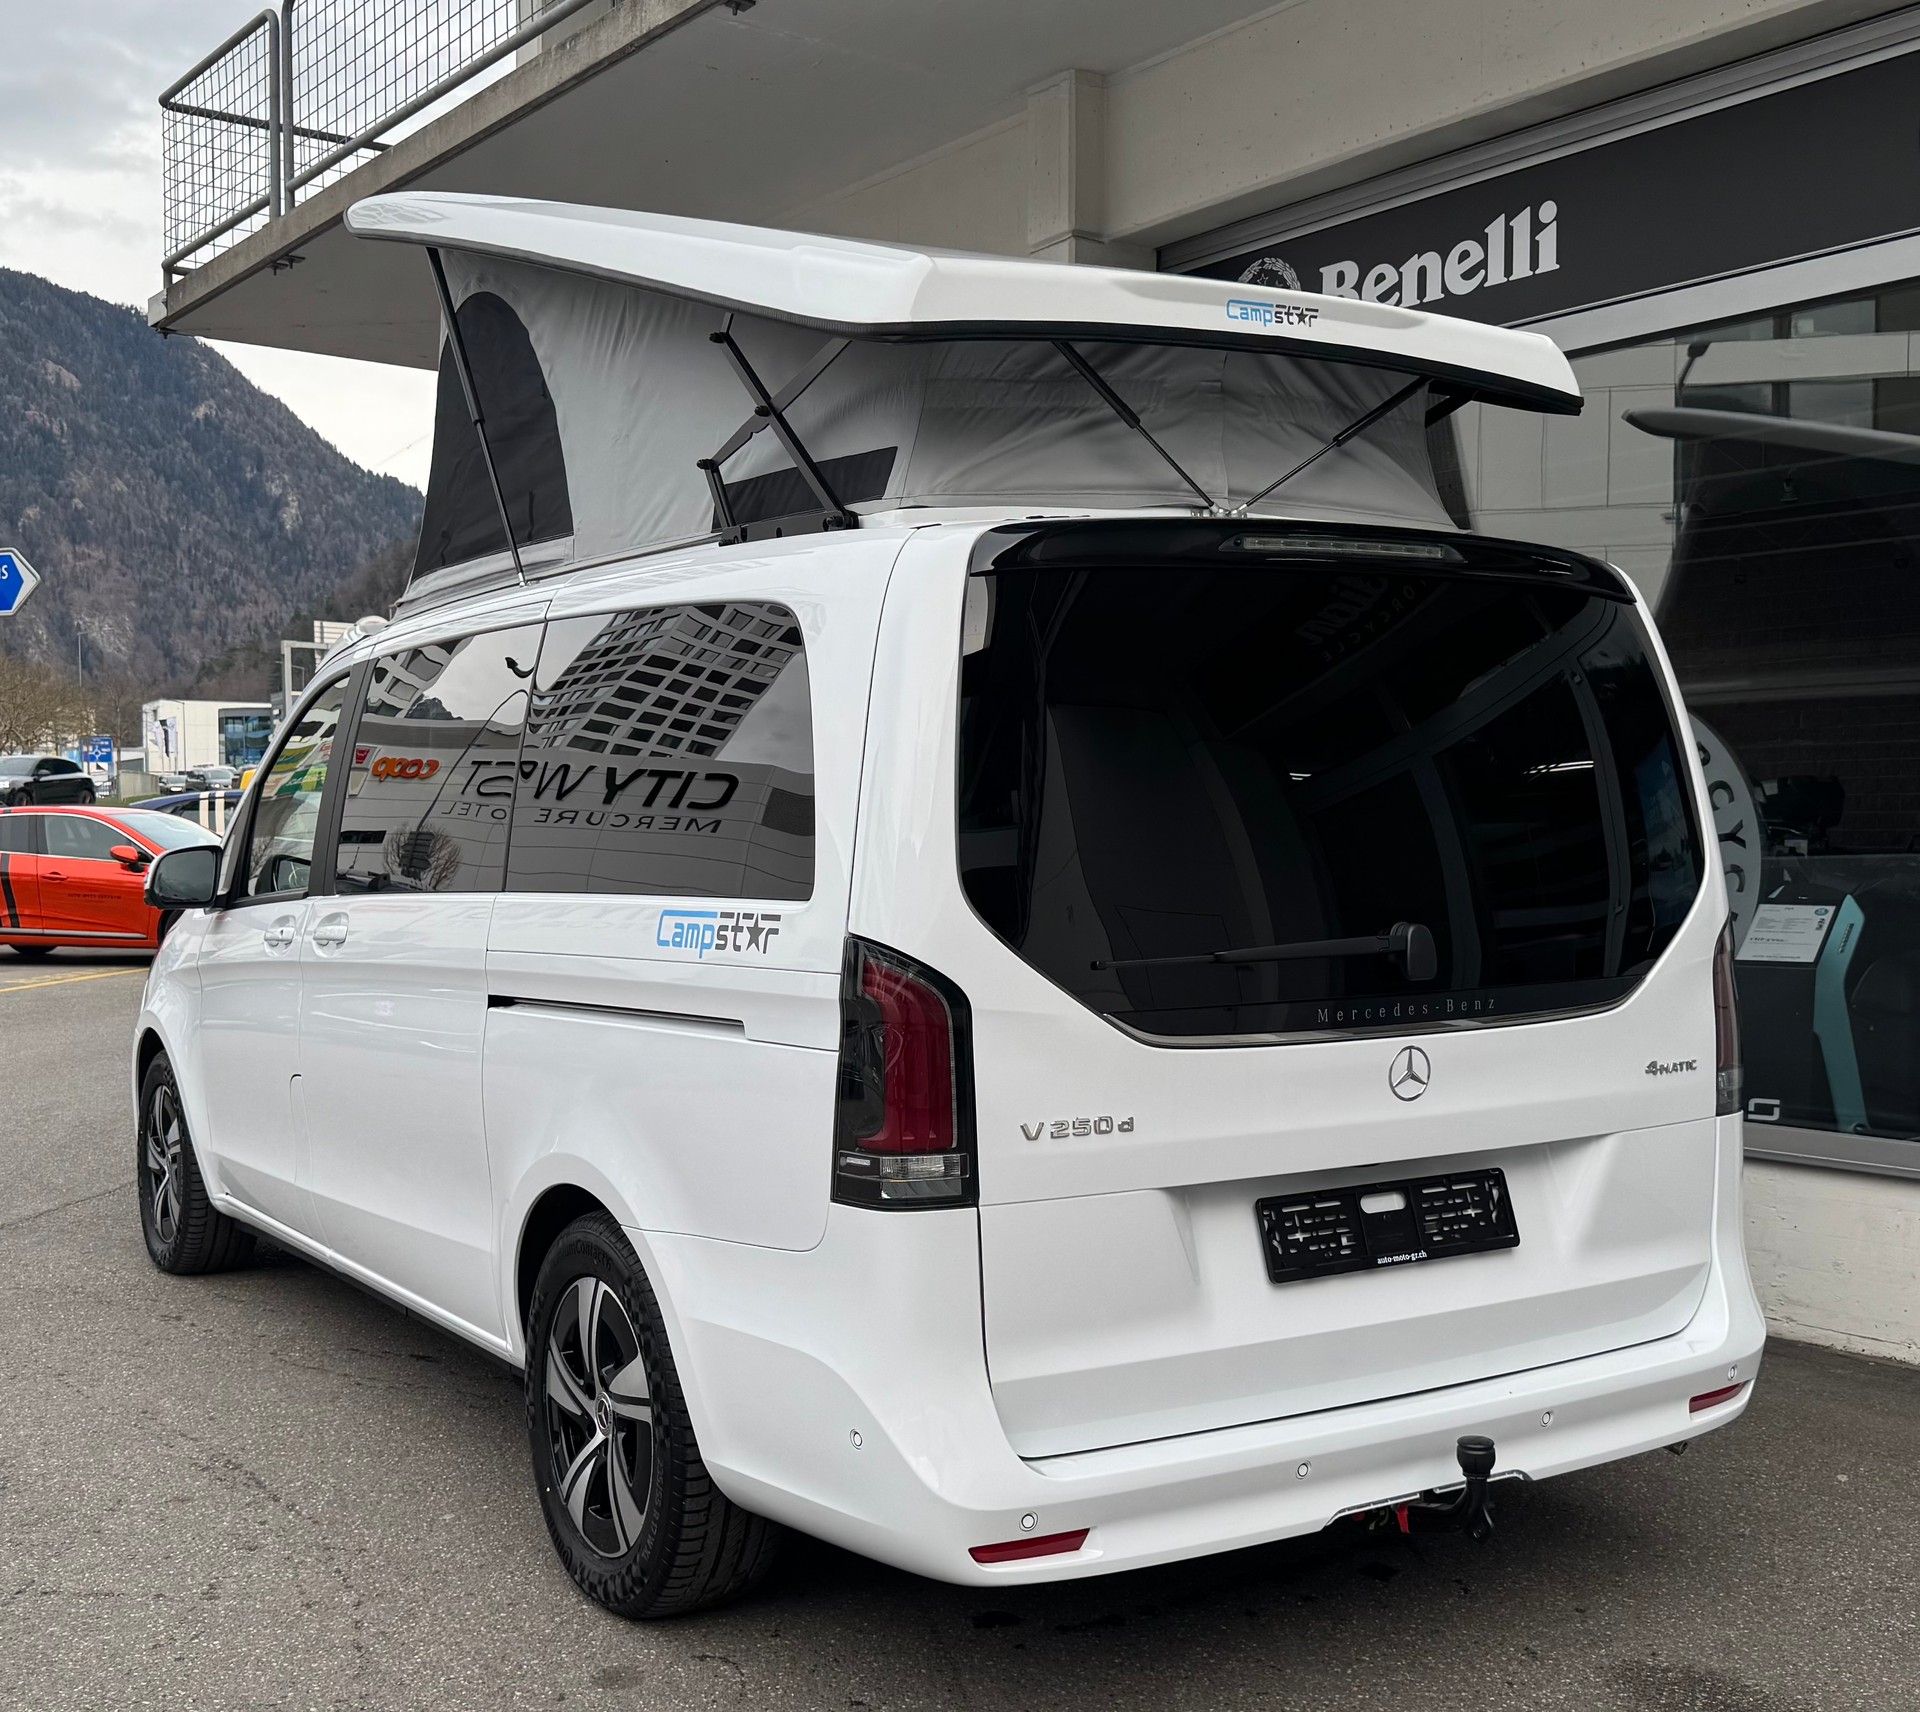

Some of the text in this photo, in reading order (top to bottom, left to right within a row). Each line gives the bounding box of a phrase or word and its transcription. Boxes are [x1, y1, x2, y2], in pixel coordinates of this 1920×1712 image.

[1319, 200, 1560, 308] Benelli
[1317, 998, 1495, 1023] Mercedes-Benz
[1020, 1121, 1045, 1141] V
